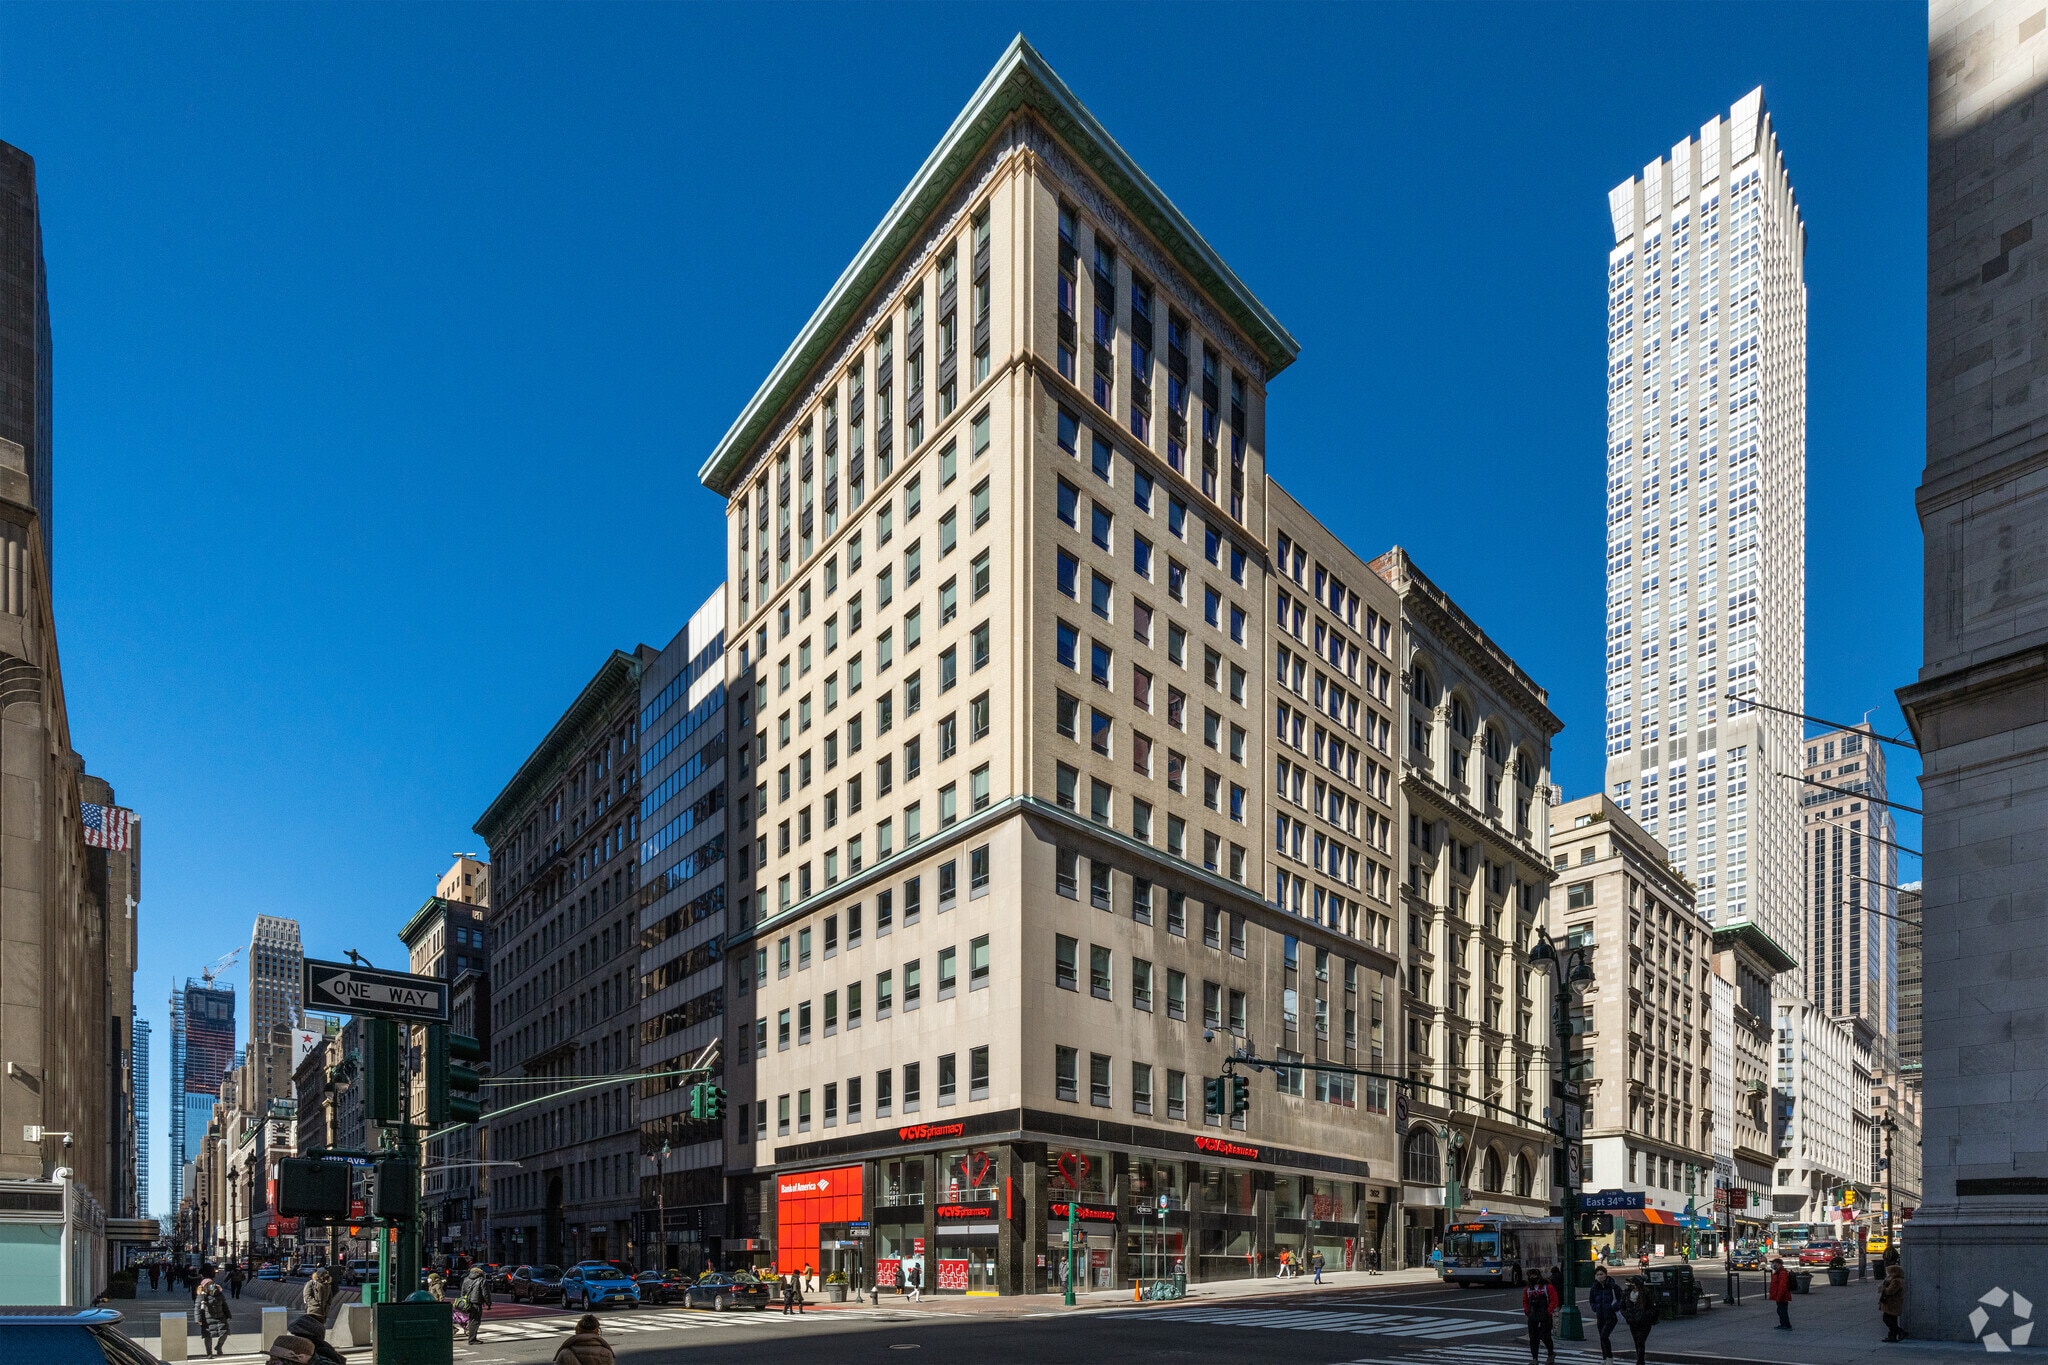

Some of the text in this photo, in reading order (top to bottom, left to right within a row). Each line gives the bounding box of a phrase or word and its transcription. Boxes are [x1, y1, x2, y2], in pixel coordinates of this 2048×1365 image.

[333, 980, 428, 1005] ONE WAY
[347, 1157, 366, 1165] Ave
[781, 1184, 793, 1193] Bank
[798, 1182, 816, 1191] America
[1586, 1197, 1636, 1206] East 34th St
